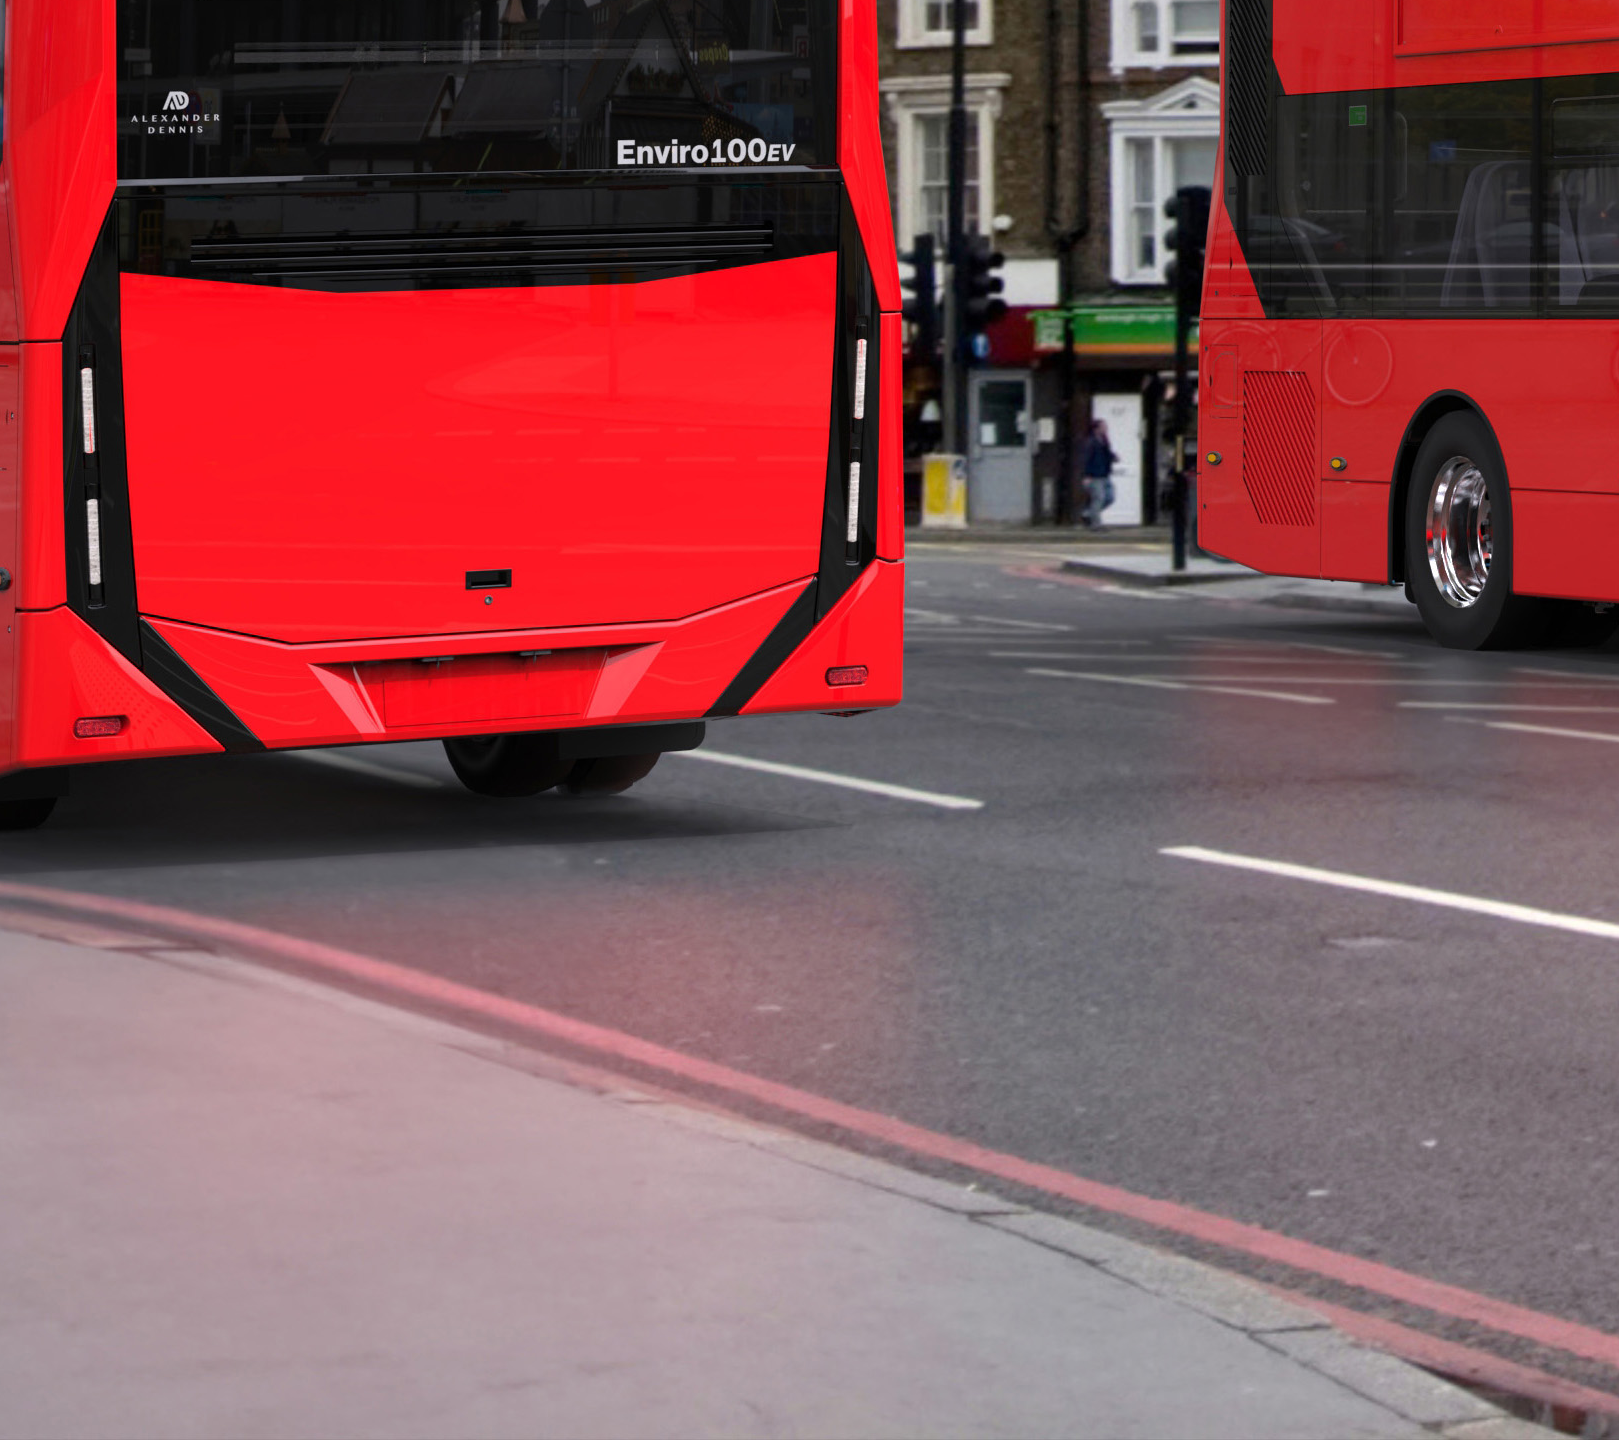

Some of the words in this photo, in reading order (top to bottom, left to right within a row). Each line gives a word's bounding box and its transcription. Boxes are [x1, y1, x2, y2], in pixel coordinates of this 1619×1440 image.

[130, 114, 220, 122] ALEXANDER
[147, 126, 203, 134] DENNIS
[617, 137, 795, 167] Enviro100EV
